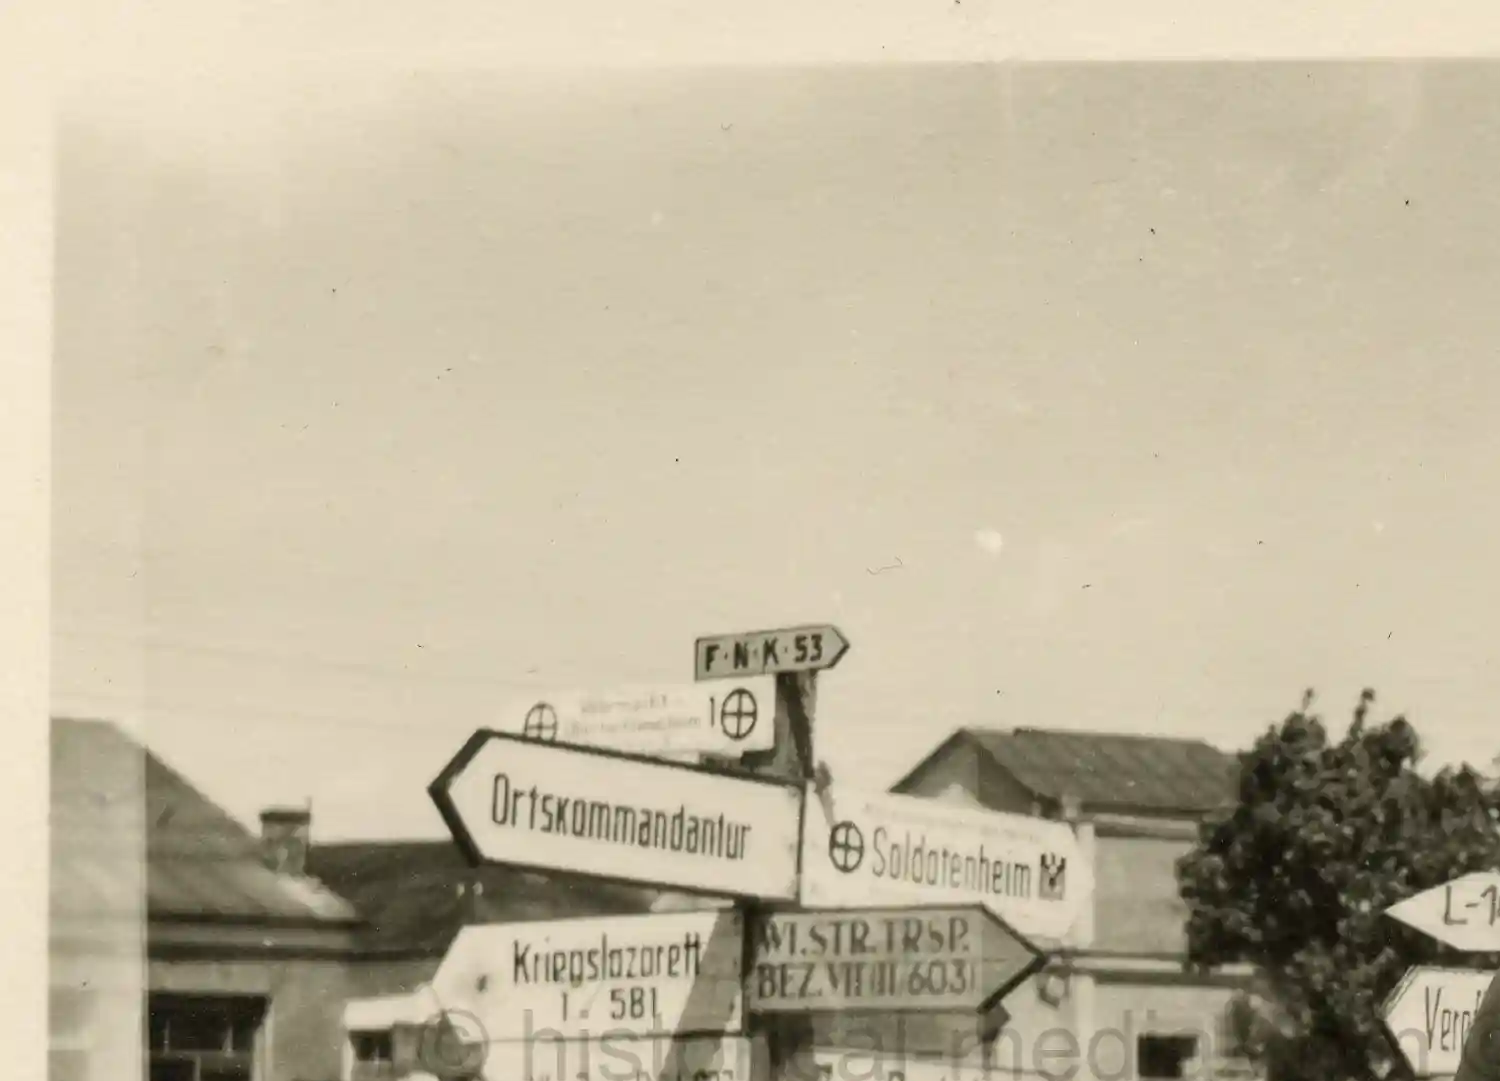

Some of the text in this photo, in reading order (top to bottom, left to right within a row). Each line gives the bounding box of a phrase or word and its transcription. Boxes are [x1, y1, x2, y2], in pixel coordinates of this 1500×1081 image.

[491, 772, 753, 860] Ortskommandantur
[871, 826, 1032, 899] Soldatenheim
[513, 932, 702, 990] Kriegslazarett
